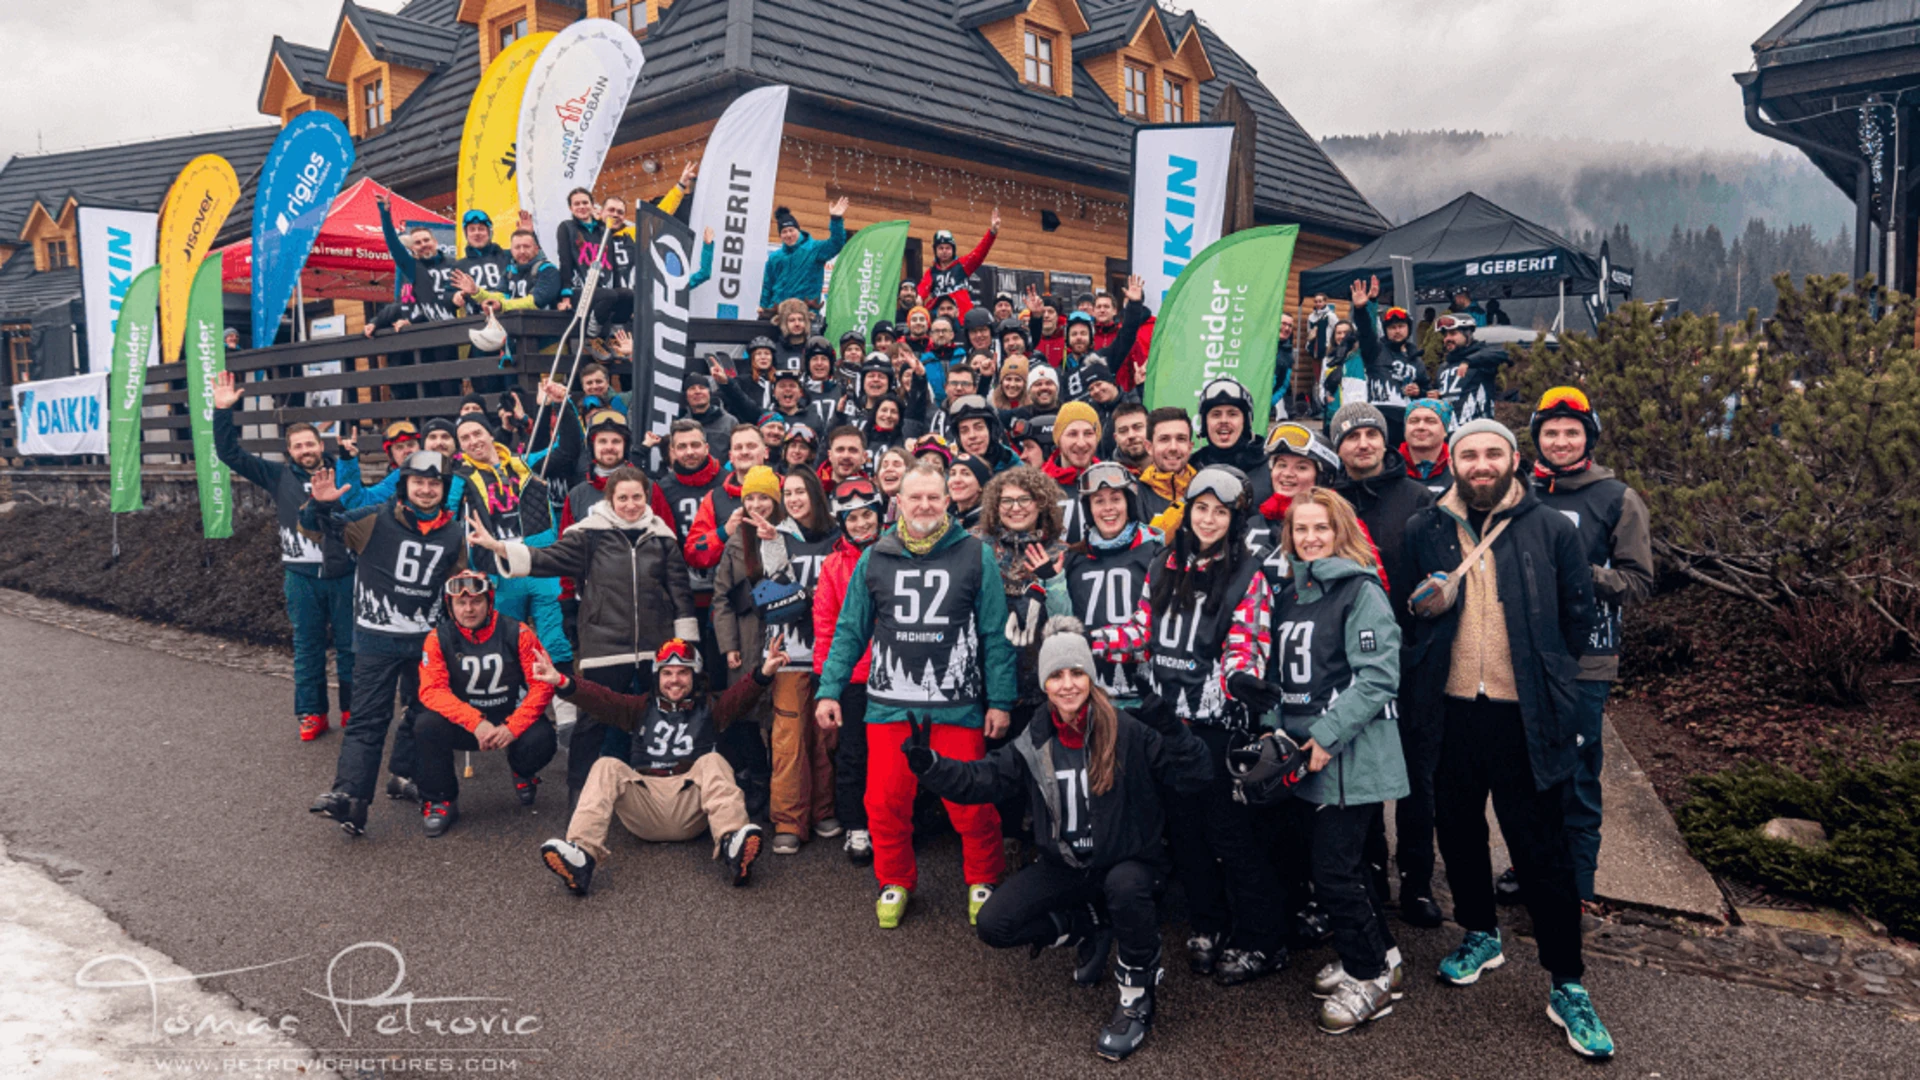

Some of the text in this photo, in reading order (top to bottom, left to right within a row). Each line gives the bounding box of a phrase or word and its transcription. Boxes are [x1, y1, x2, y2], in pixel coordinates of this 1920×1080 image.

[564, 75, 609, 180] SAINT-GOBAIN
[287, 151, 325, 217] rigips
[719, 163, 752, 299] GEBERIT
[470, 262, 501, 289] 28
[1481, 256, 1557, 275] GEBERIT
[1223, 284, 1248, 369] Electric
[198, 320, 213, 422] Schneider
[37, 395, 100, 434] DAIKIN
[394, 540, 444, 586] 67
[894, 569, 950, 625] 52
[1081, 567, 1133, 626] 70
[461, 653, 509, 695] 22
[647, 719, 694, 756] 35
